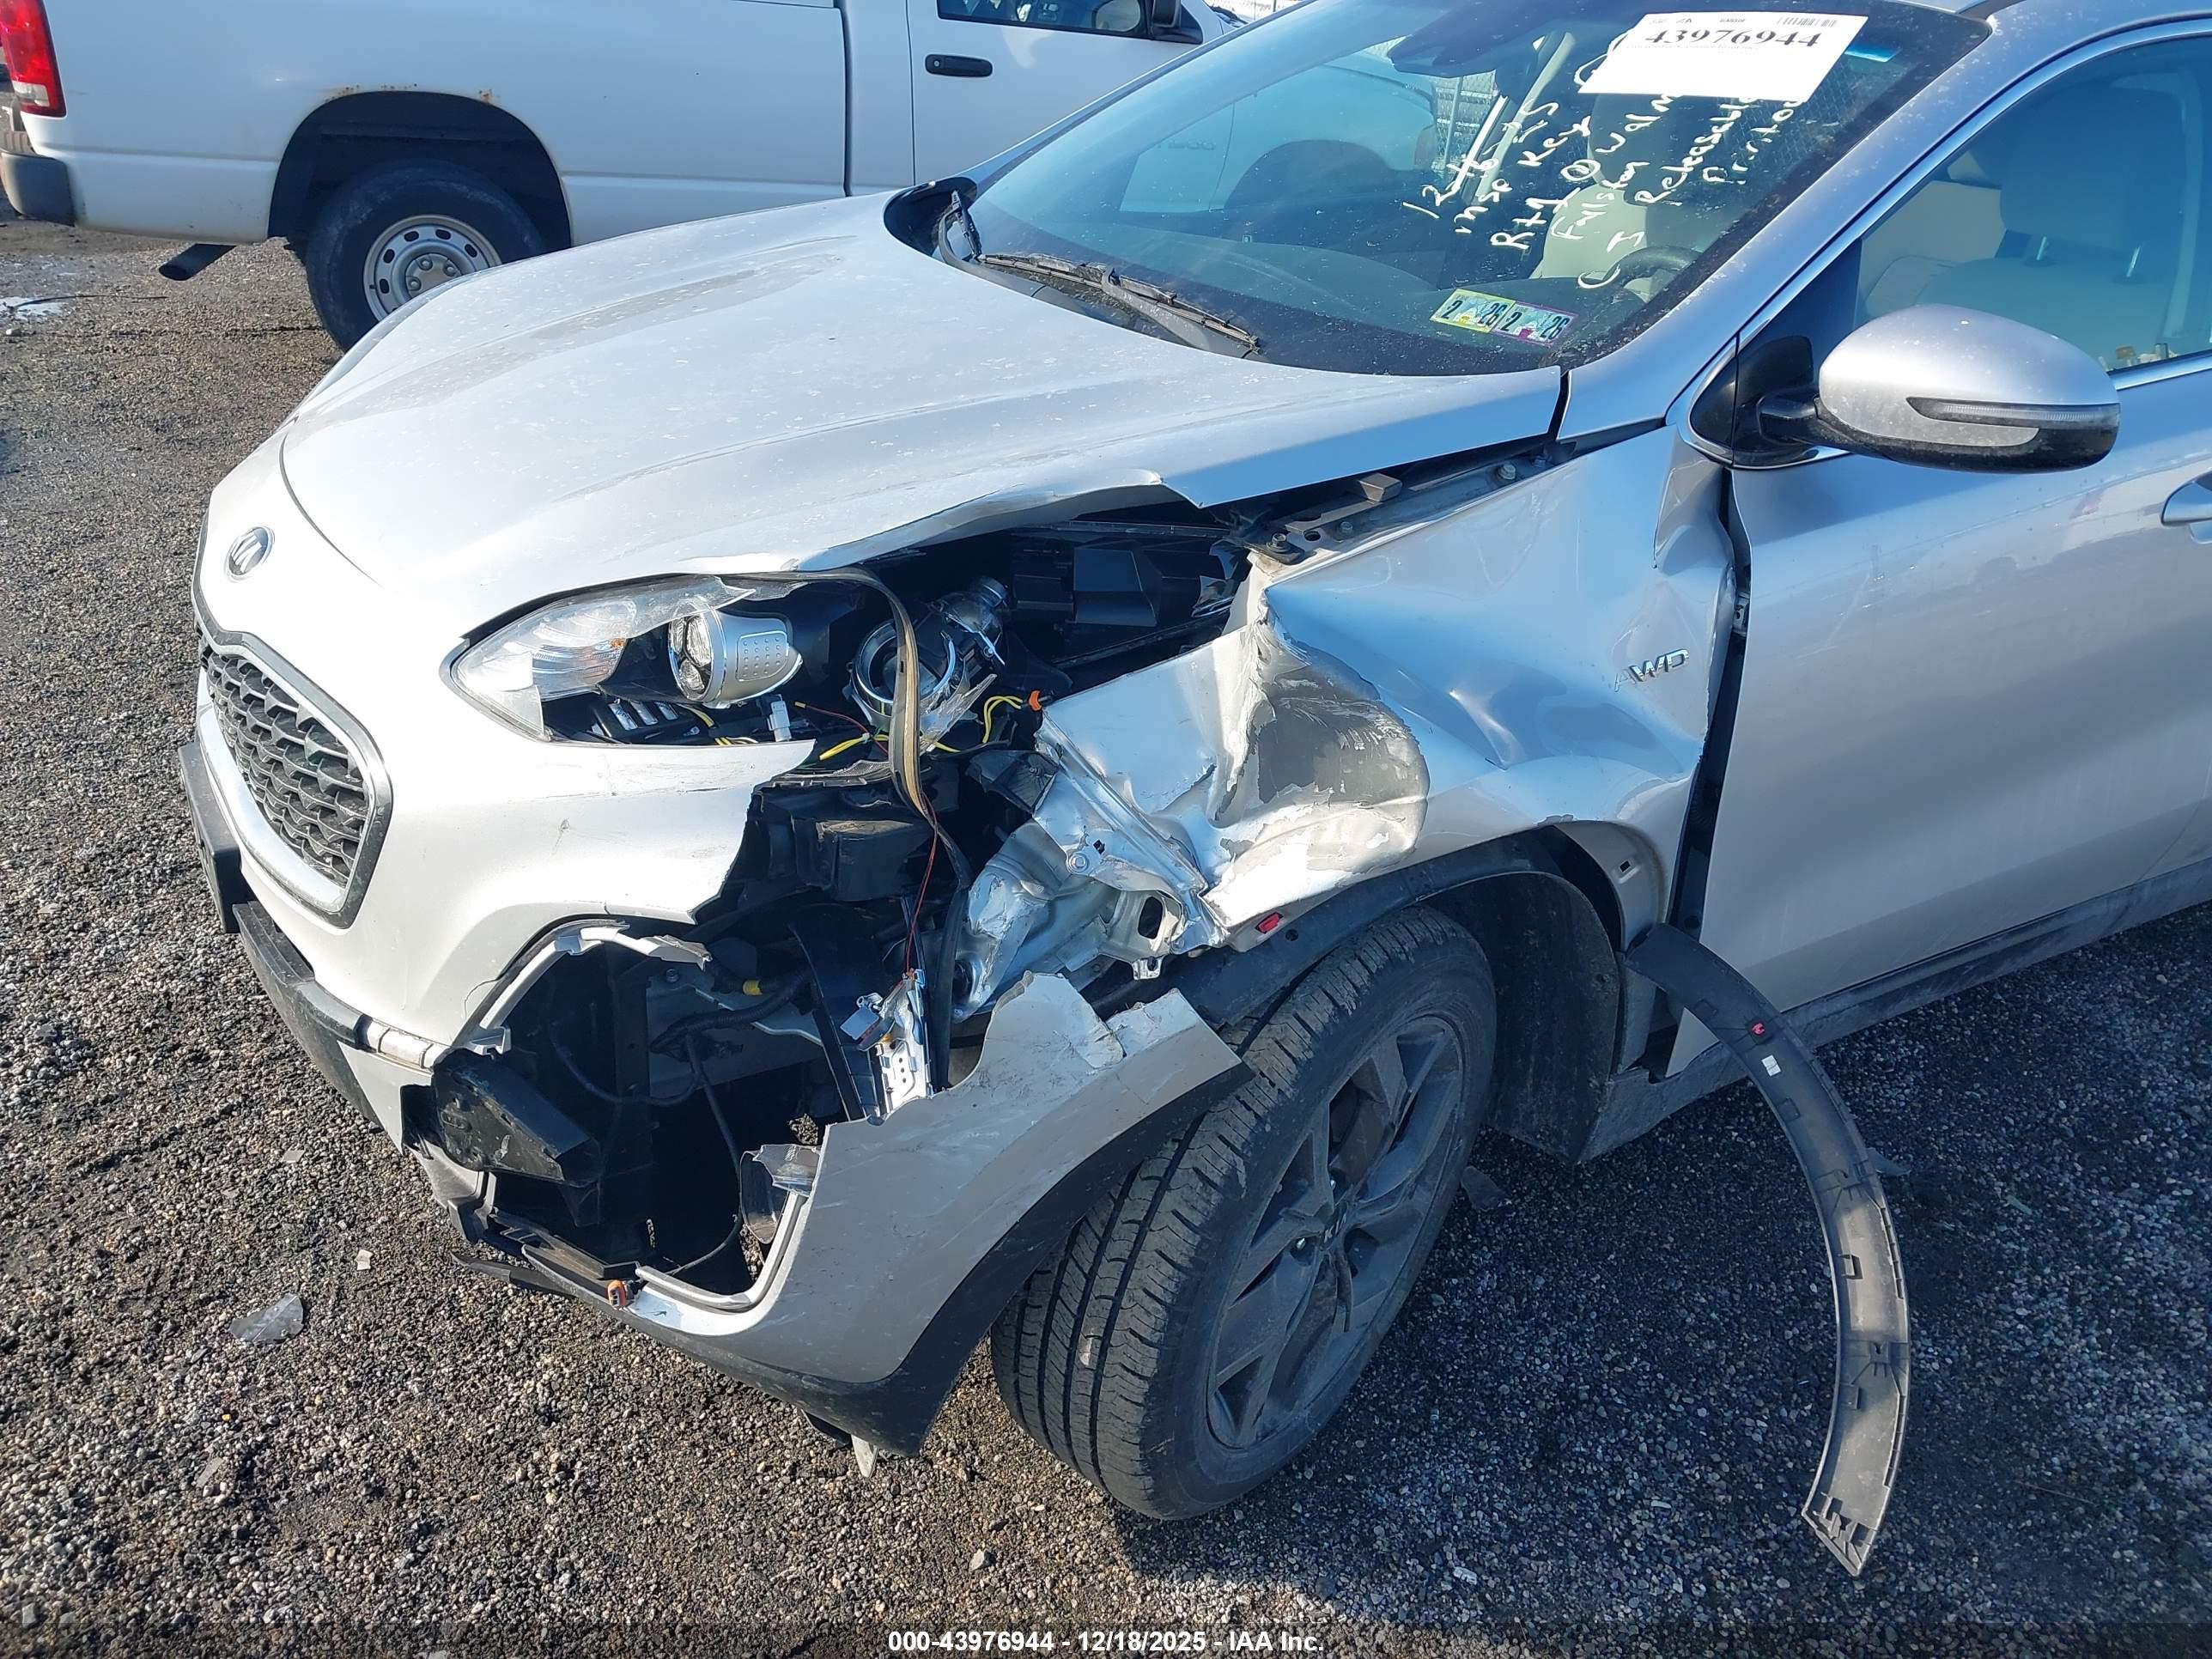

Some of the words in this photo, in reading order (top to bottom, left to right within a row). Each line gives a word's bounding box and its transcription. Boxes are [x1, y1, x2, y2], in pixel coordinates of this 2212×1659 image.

[1644, 29, 1822, 47] 43976944
[1441, 301, 1463, 319] 2
[1478, 302, 1508, 326] 26
[1500, 311, 1523, 331] 2
[1540, 315, 1571, 340] 26
